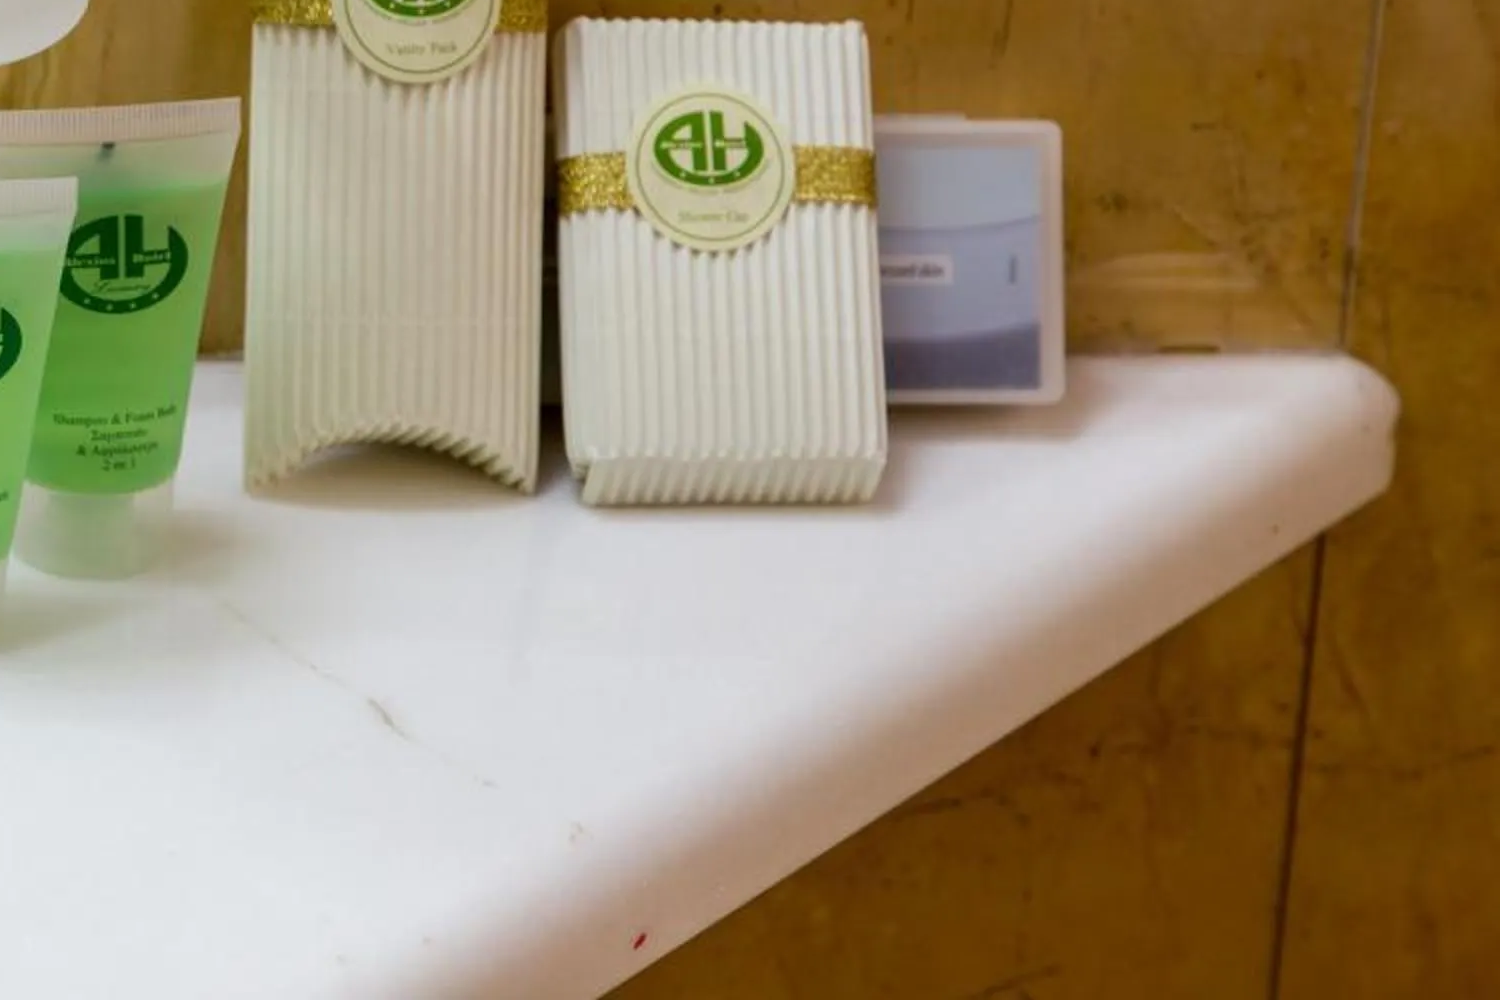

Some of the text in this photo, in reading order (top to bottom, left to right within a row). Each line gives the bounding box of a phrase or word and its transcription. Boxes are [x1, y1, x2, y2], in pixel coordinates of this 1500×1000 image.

[53, 411, 109, 427] Shampoo
[111, 413, 122, 425] &
[125, 410, 156, 424] Foam
[76, 444, 86, 457] &
[102, 459, 111, 472] 2
